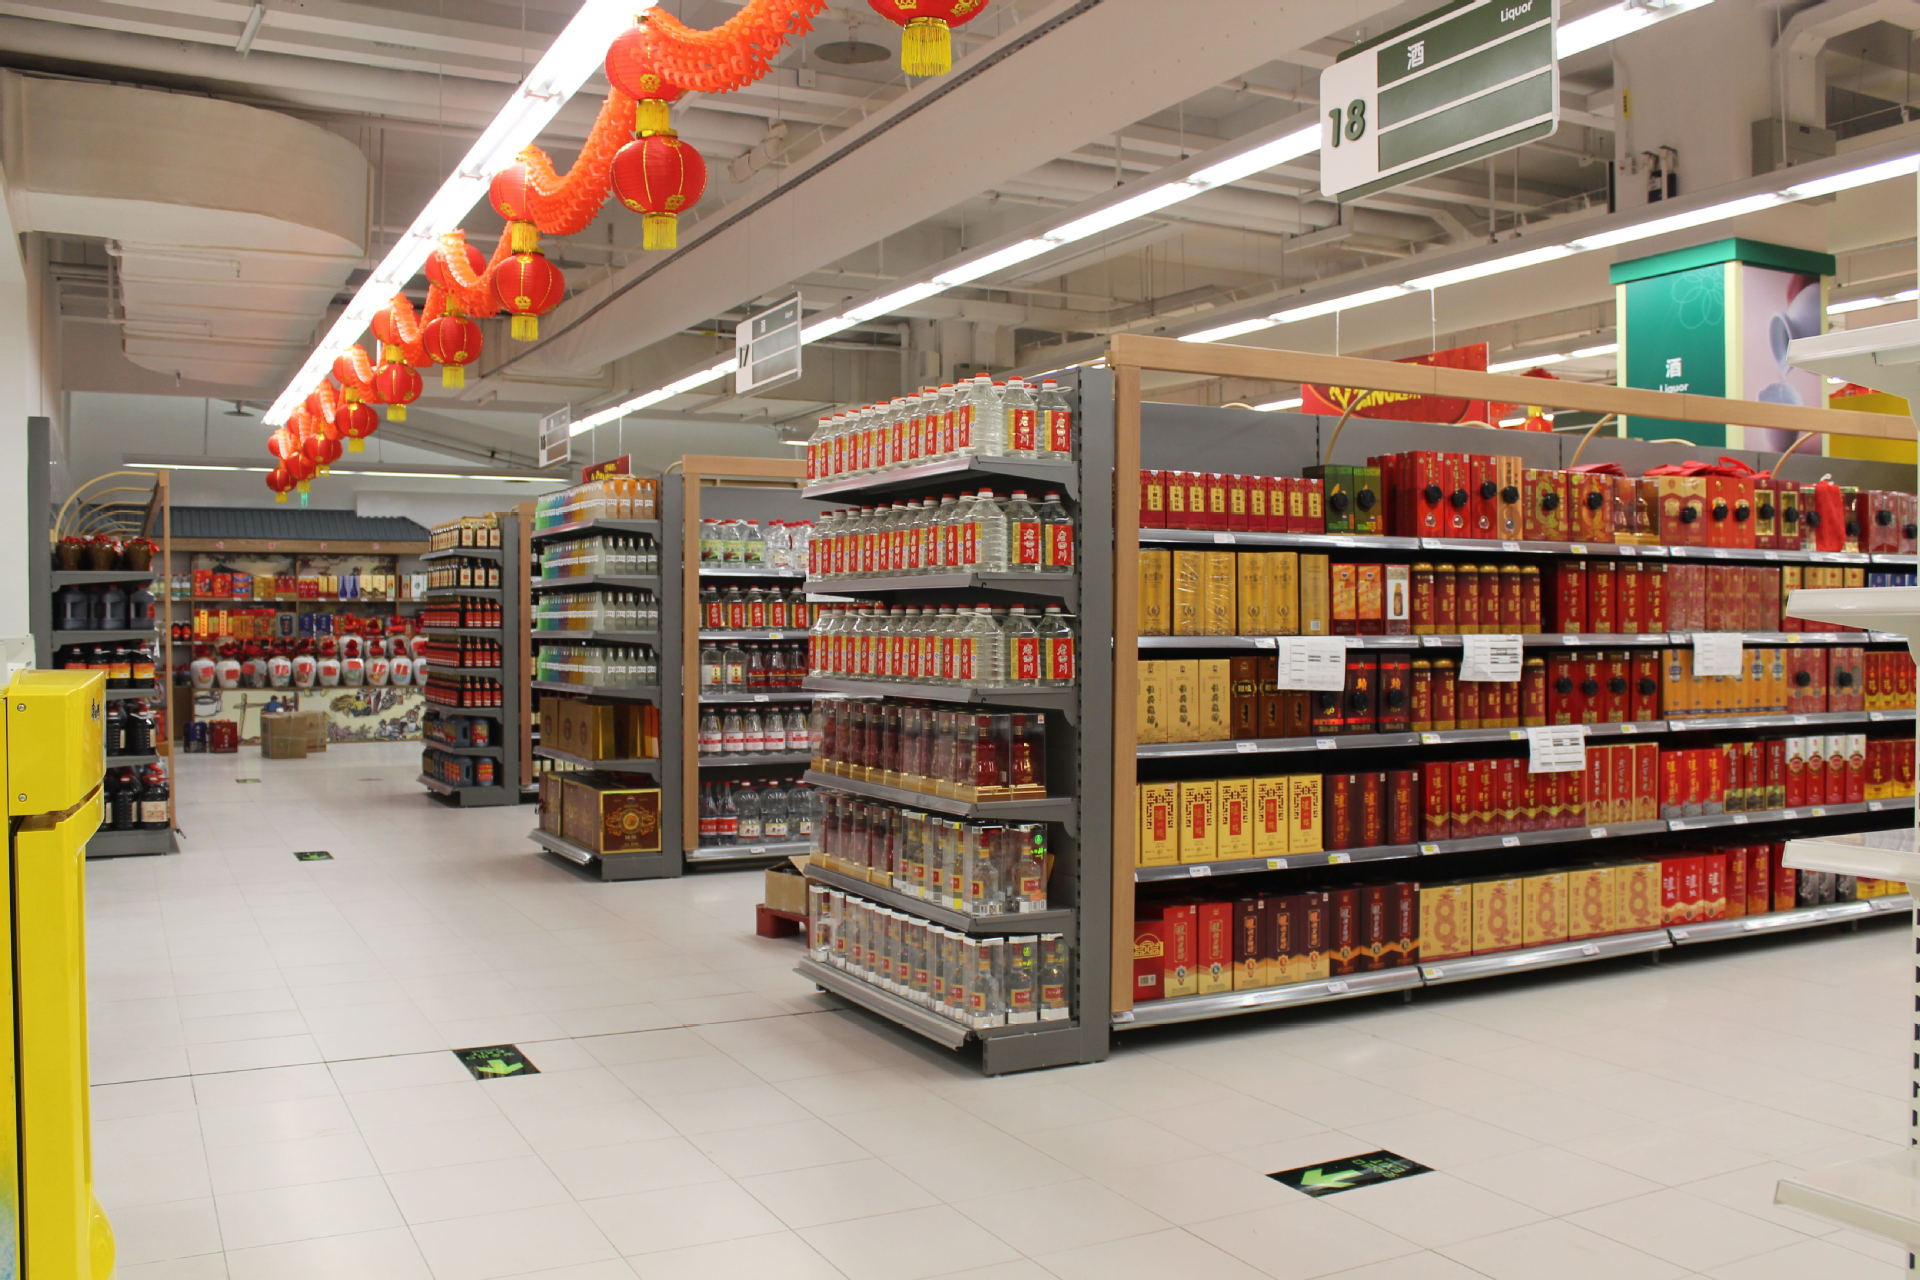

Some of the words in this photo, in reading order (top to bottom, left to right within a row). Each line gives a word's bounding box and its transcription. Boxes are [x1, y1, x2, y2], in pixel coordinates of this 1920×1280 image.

[1500, 1, 1533, 22] Liquor
[1407, 40, 1425, 70] 酒
[1328, 99, 1366, 148] 18
[738, 344, 750, 369] 17
[1665, 357, 1682, 378] 酒
